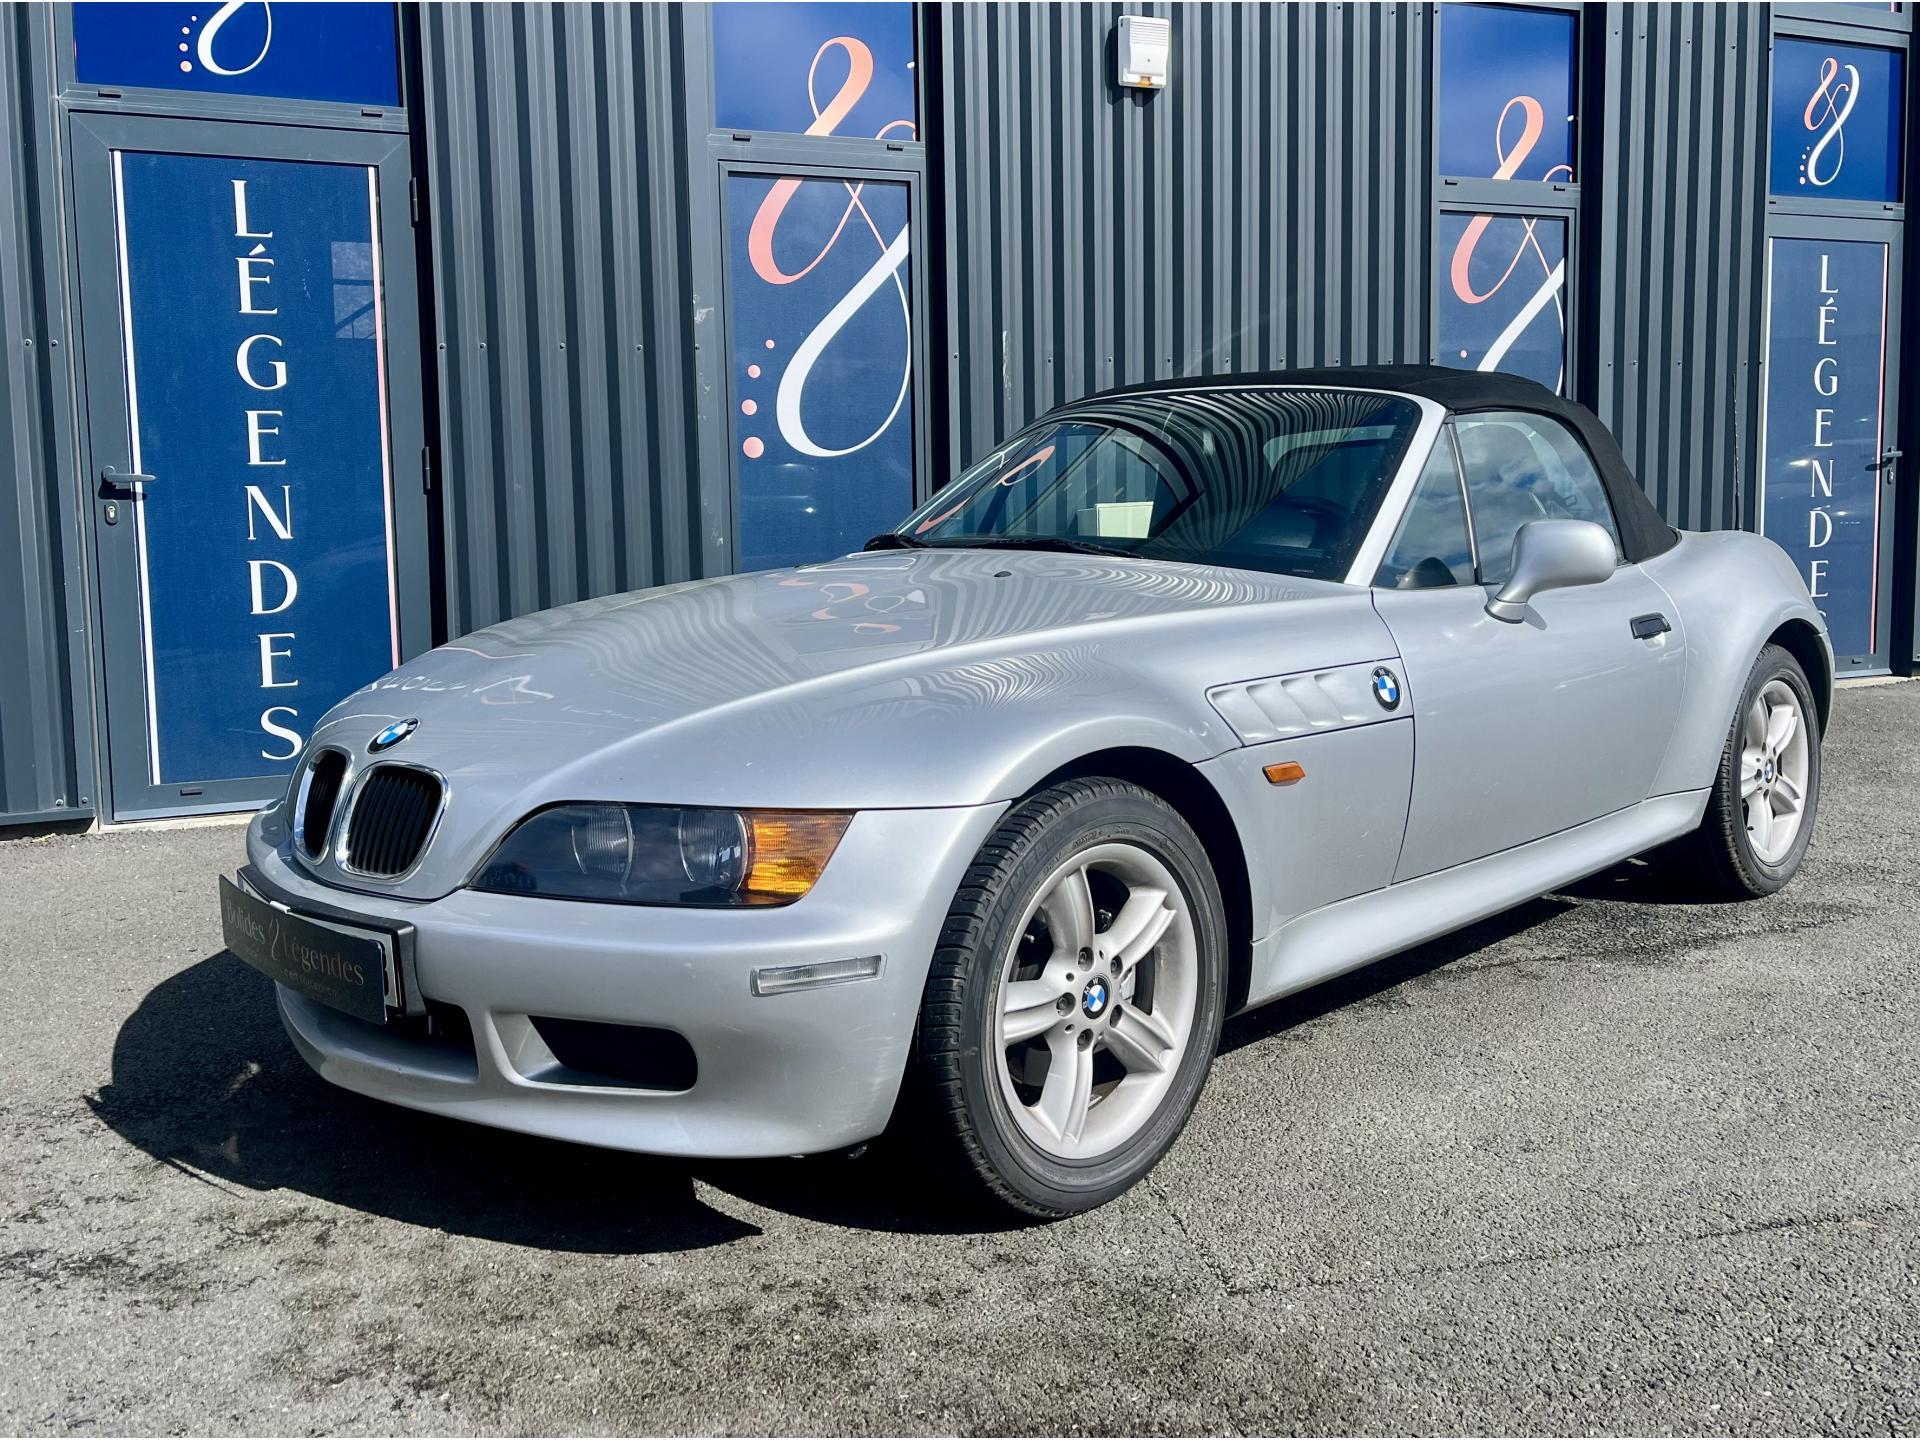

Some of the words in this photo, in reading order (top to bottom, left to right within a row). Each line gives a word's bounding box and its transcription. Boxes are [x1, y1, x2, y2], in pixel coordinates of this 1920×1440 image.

[231, 179, 303, 761] LÉGENDES
[1809, 254, 1839, 632] LÉGENDE
[226, 897, 266, 945] Bolides
[282, 932, 365, 986] Légendes
